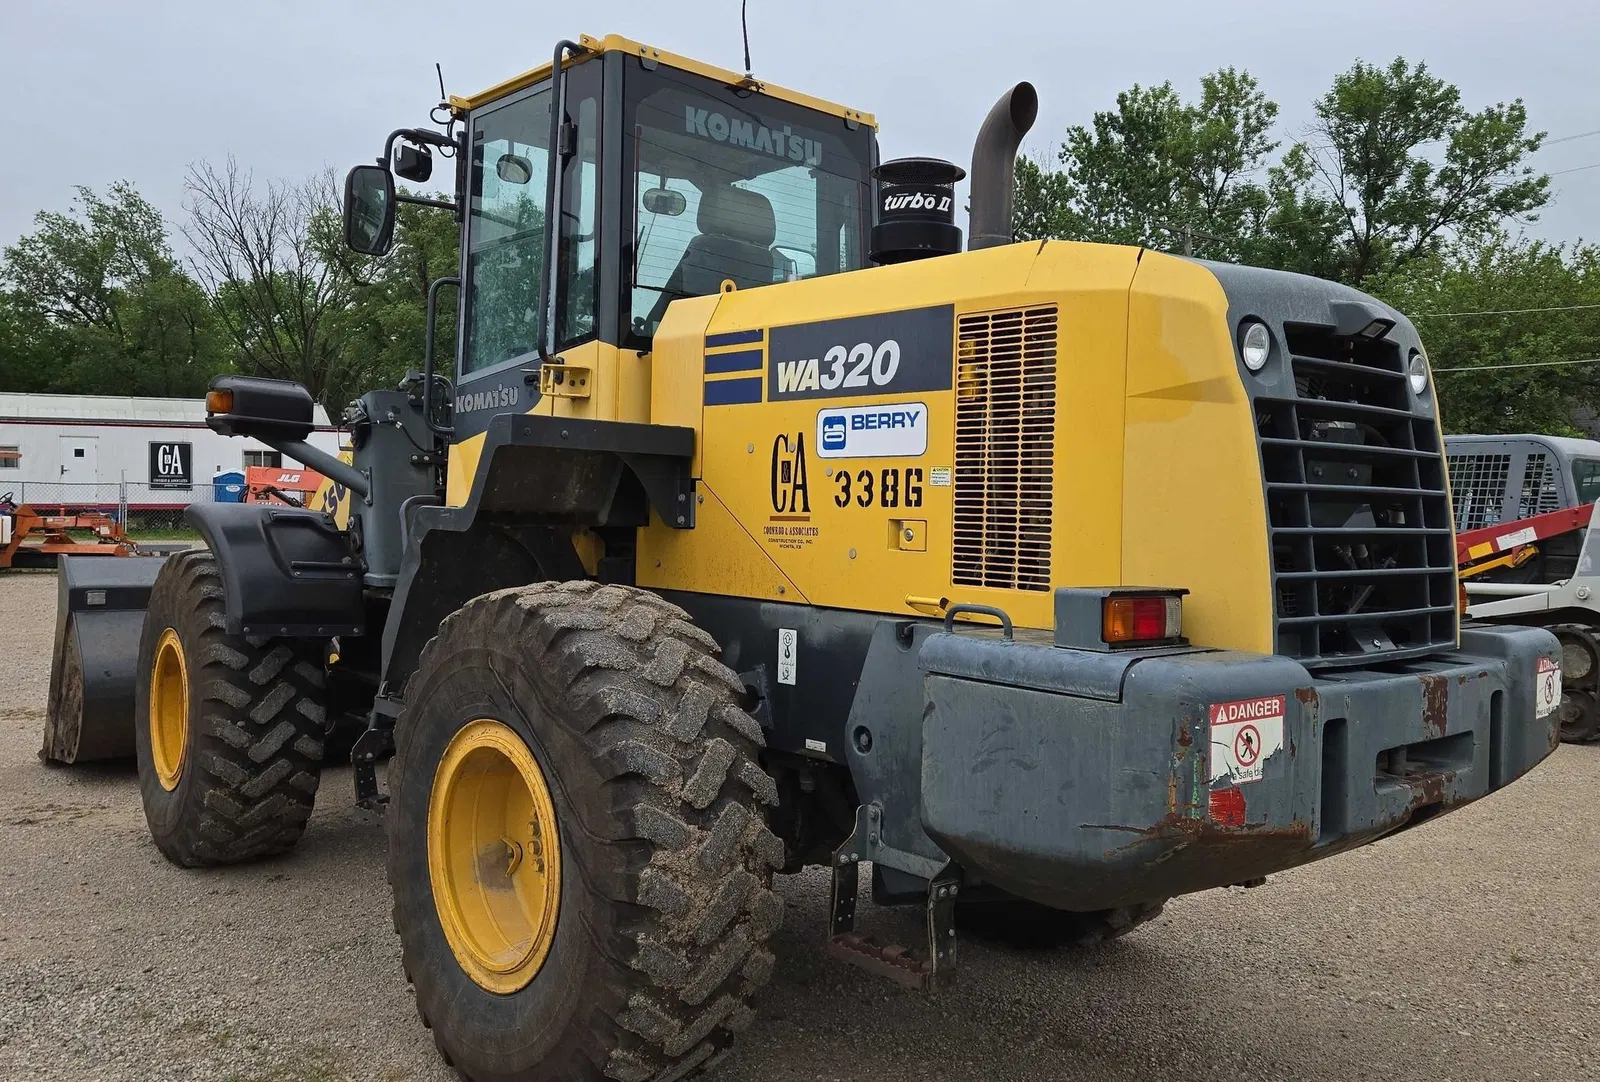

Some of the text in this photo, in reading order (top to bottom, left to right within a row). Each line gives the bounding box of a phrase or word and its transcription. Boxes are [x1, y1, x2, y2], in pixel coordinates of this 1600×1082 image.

[685, 105, 822, 166] KOMATSU
[884, 192, 951, 212] turbo II
[777, 339, 901, 393] WA320
[455, 383, 519, 414] KOMATSU
[851, 410, 920, 430] BERRY
[276, 473, 301, 483] JLG
[834, 468, 923, 508] 338G
[789, 527, 818, 536] ASSOCIATES
[1229, 699, 1280, 720] DANGER
[1238, 767, 1253, 780] safe
